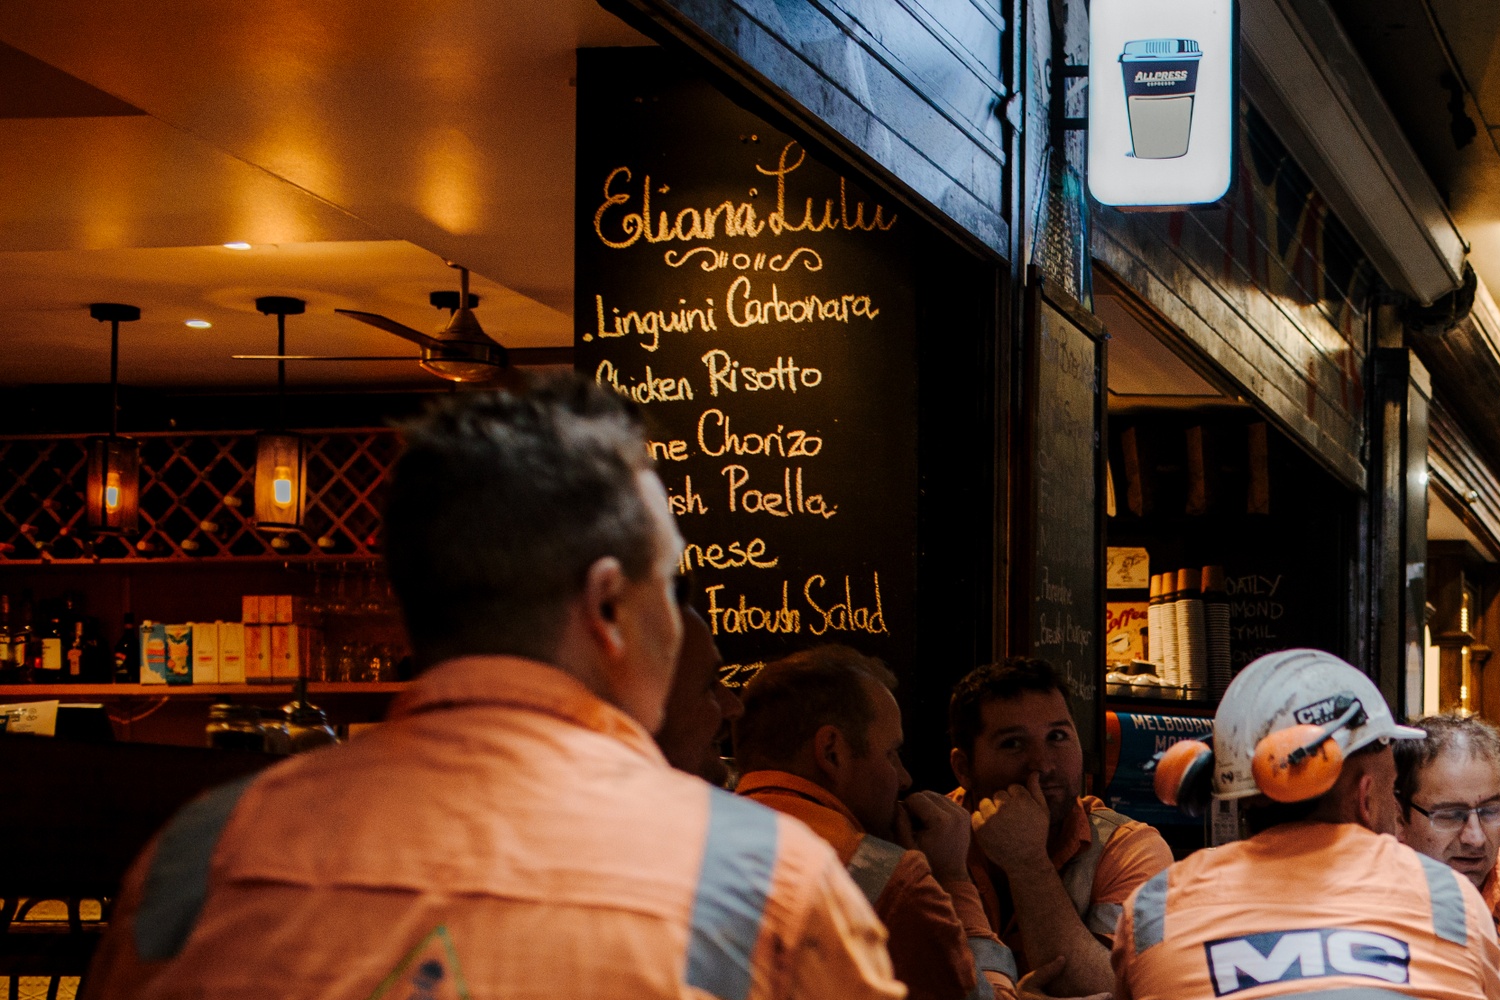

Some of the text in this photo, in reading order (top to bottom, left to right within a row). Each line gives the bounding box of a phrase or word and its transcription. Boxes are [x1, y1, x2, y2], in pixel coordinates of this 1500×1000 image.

[1134, 70, 1188, 82] ALLPRESS
[756, 140, 898, 236] Lulu
[596, 276, 880, 352] Linguini Carbonara
[702, 349, 823, 396] Risotto
[697, 408, 823, 457] Chorizo
[803, 571, 891, 638] Salad
[1130, 713, 1215, 733] MELBOURN
